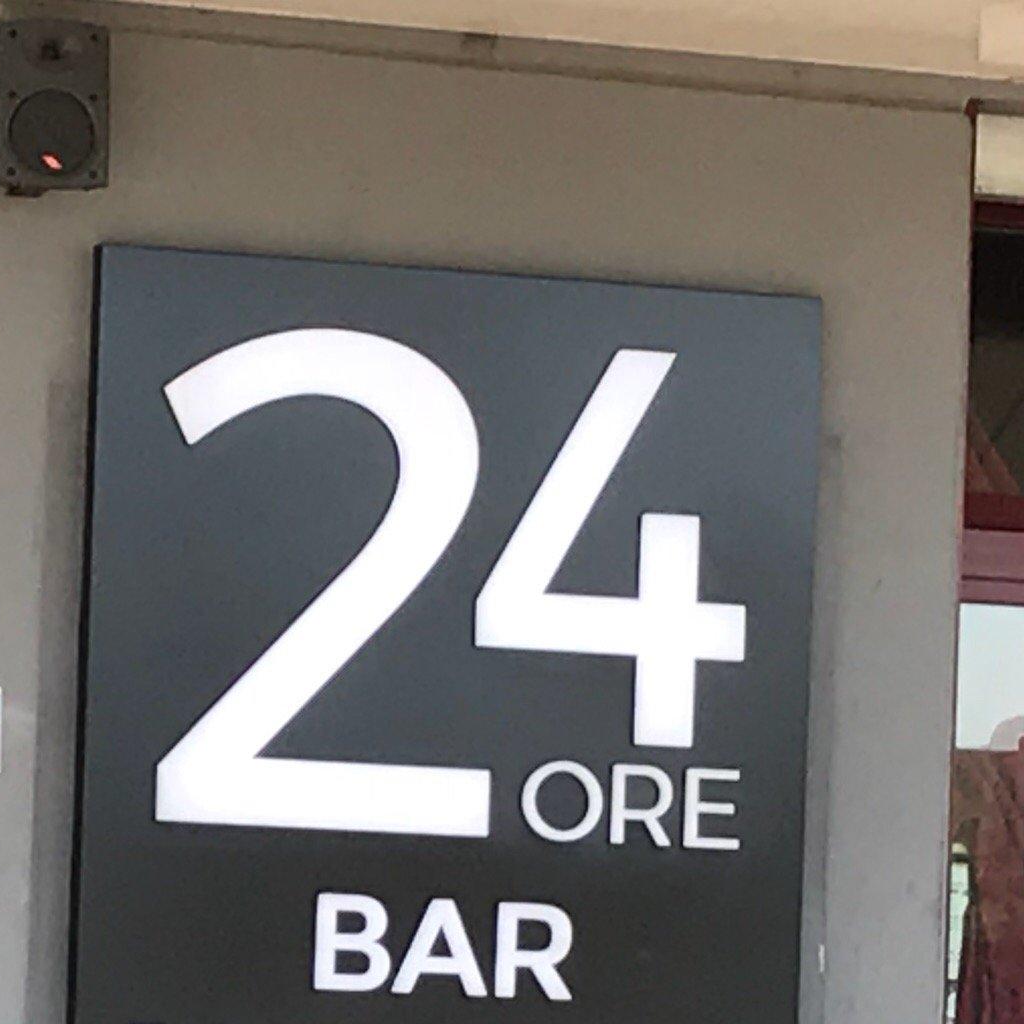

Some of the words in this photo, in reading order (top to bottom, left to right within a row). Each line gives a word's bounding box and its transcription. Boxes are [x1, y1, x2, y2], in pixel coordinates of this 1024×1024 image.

[155, 328, 747, 838] 24
[521, 760, 741, 850] ORE
[314, 892, 573, 1002] BAR
